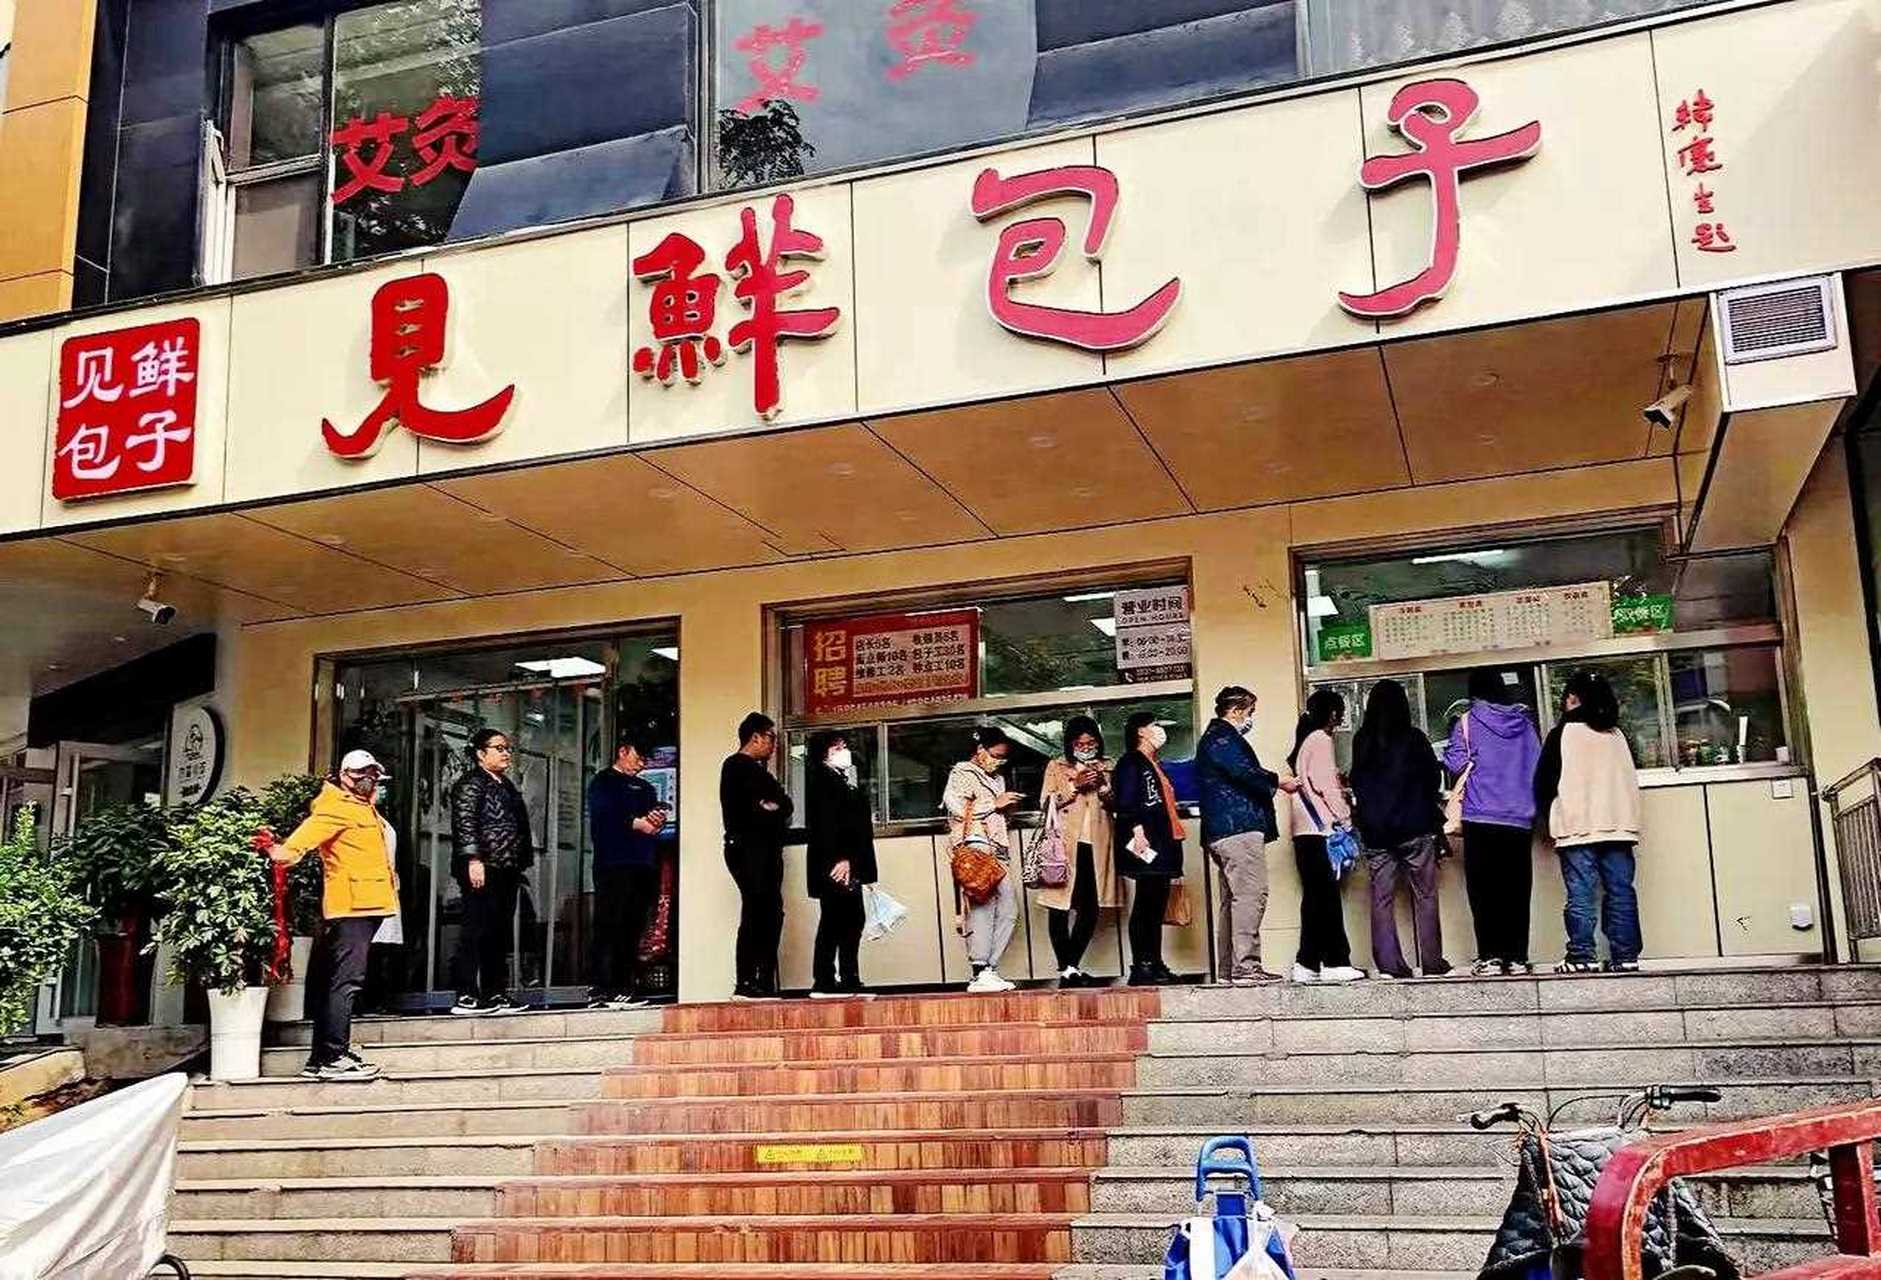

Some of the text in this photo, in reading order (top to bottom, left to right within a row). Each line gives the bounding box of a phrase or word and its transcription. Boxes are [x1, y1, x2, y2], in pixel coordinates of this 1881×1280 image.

[332, 94, 480, 204] 艾灸
[62, 336, 195, 409] 见鲜
[57, 409, 192, 480] 包子
[1121, 596, 1182, 615] 营业时间
[814, 630, 848, 698] 招聘
[1324, 633, 1366, 650] 点餐区
